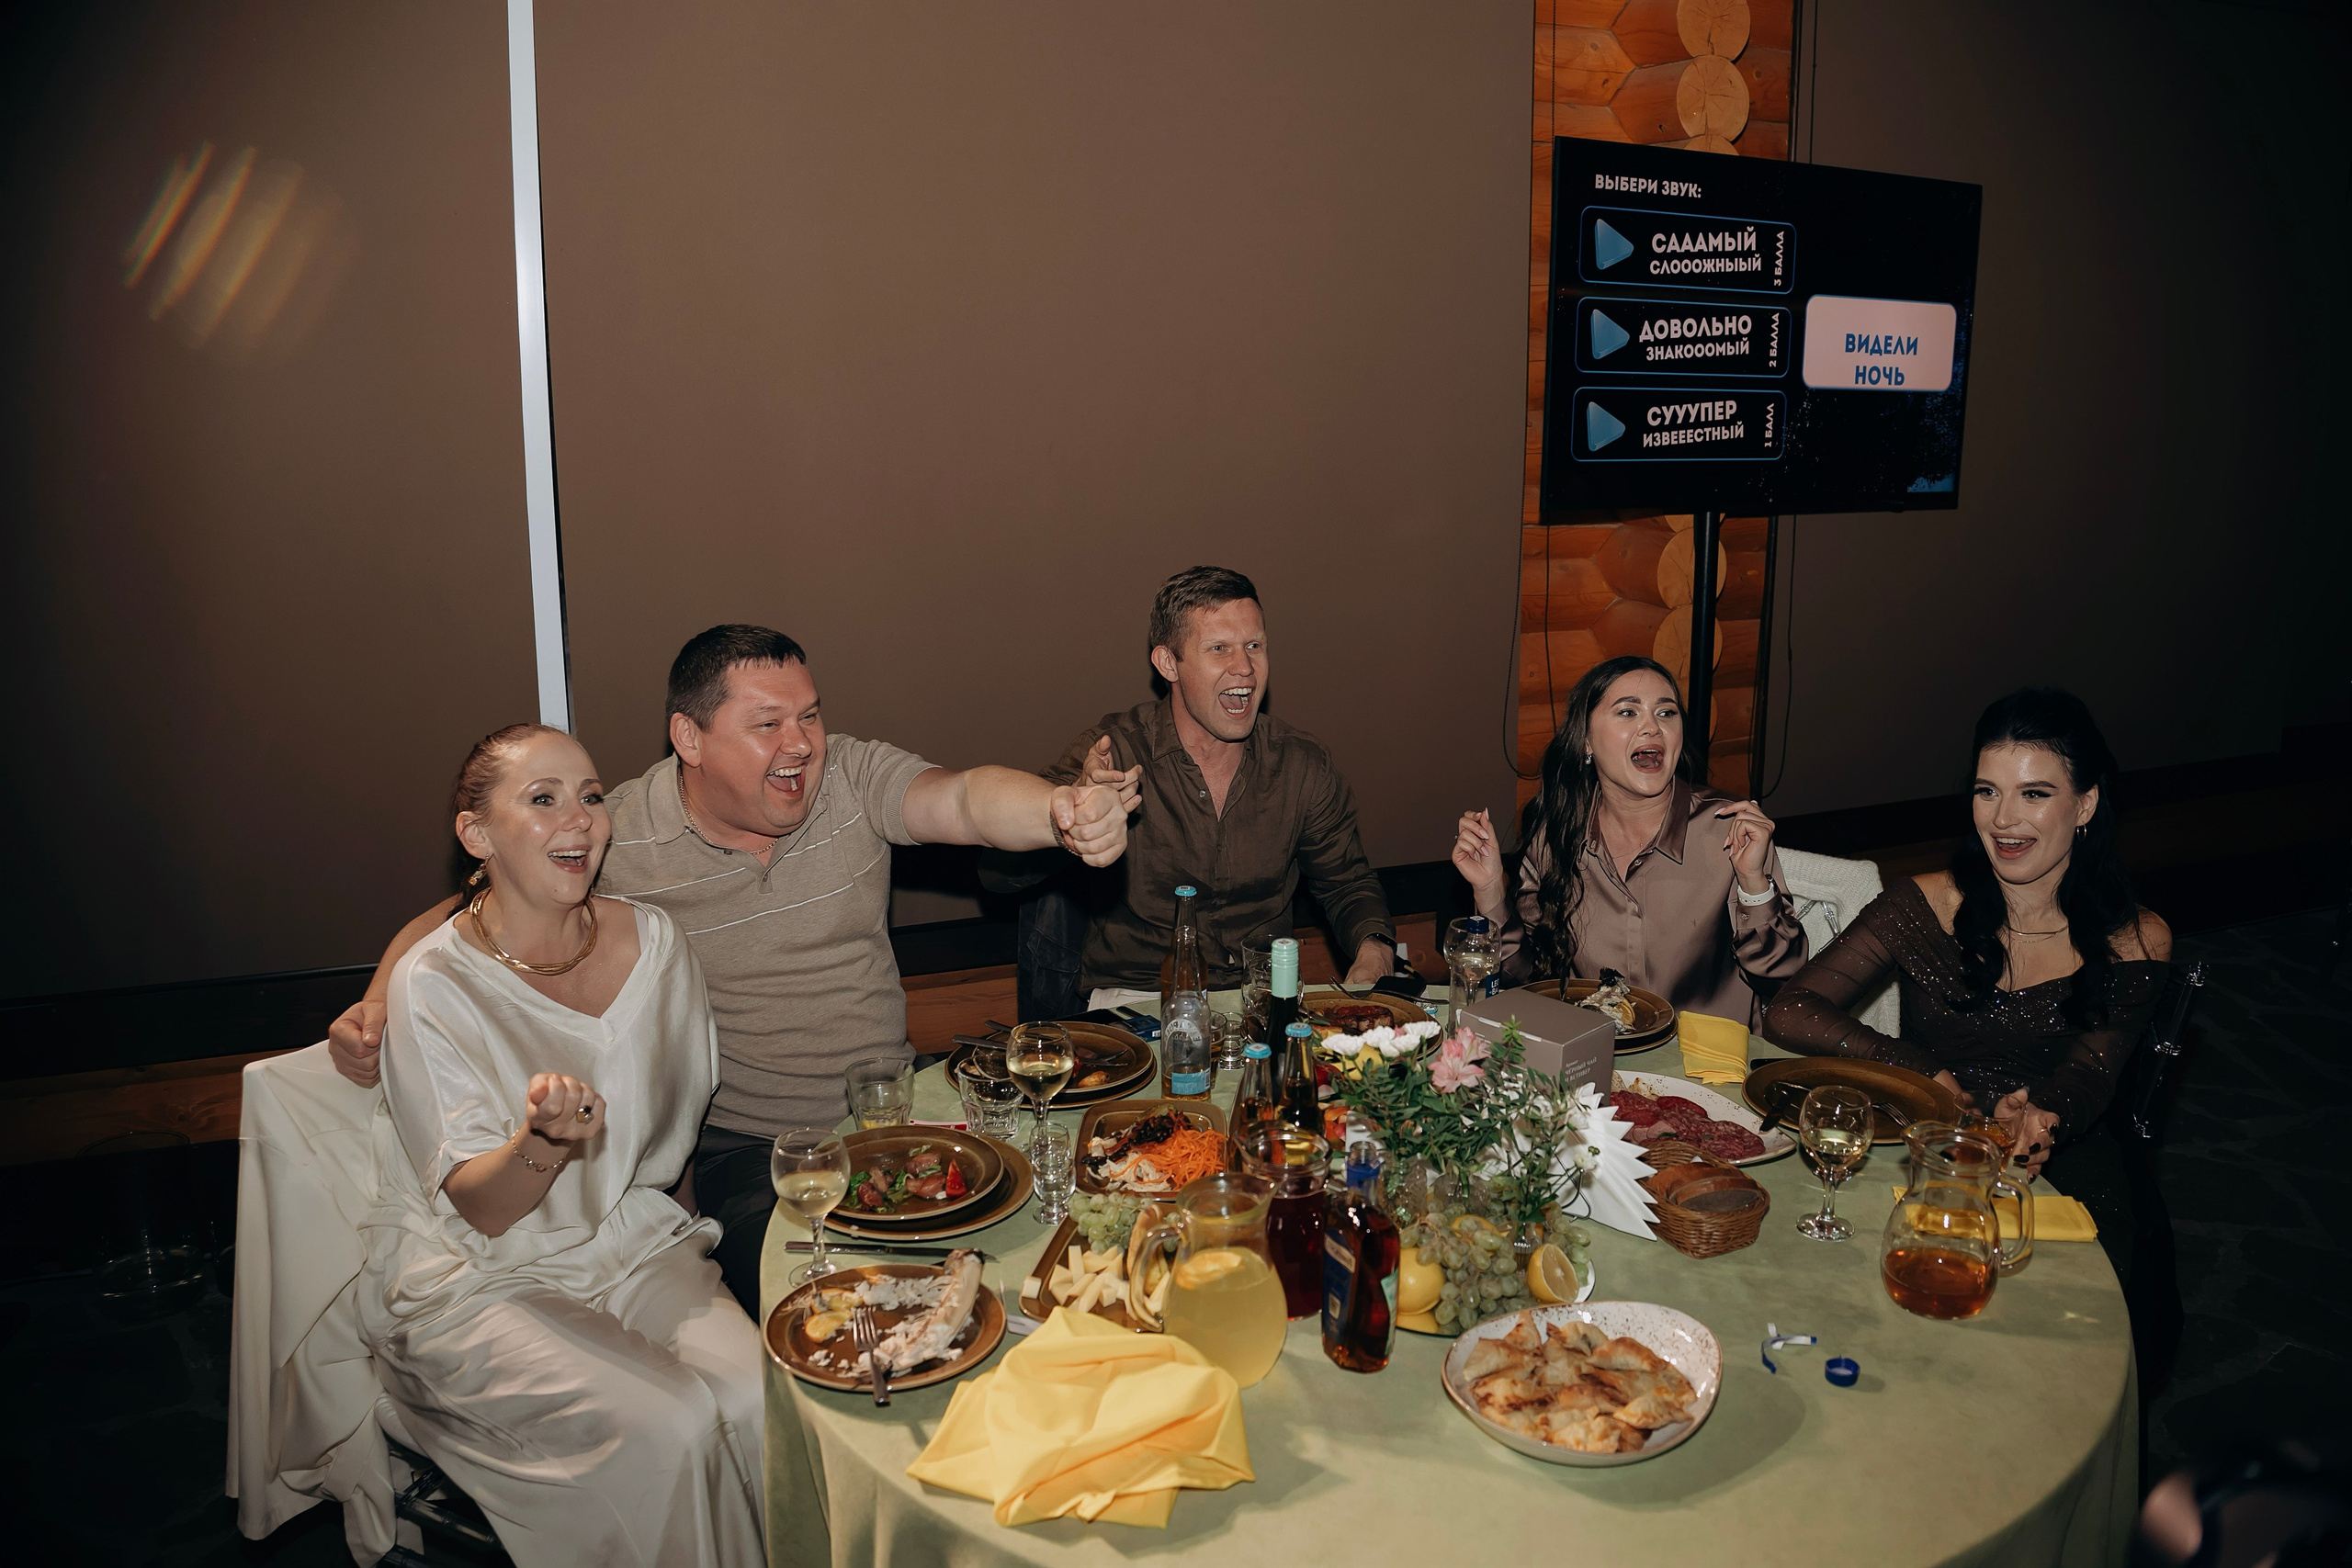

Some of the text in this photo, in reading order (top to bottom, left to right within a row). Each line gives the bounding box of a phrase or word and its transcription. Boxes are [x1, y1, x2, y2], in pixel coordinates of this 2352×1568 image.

[1595, 174, 1702, 198] ВЫБЕРИ ЗВУК:
[1651, 226, 1757, 254] САААМЫЙ
[1649, 253, 1761, 275] СЛОООЖНЫЫЙ
[1773, 231, 1784, 287] 3 БАЛЛА
[1639, 314, 1752, 343] ДОВОЛЬНО
[1770, 312, 1780, 357] БАЛЛА
[1645, 337, 1749, 361] ЗНАКОООМЫЙ
[1845, 333, 1918, 356] ВИДЕЛИ
[1854, 365, 1905, 386] НОЧЬ
[1646, 400, 1737, 427] СУУУПЕР
[1765, 402, 1775, 438] БАЛЛ
[1643, 421, 1745, 448] ИЗВЕЕЕСТНЫЙ
